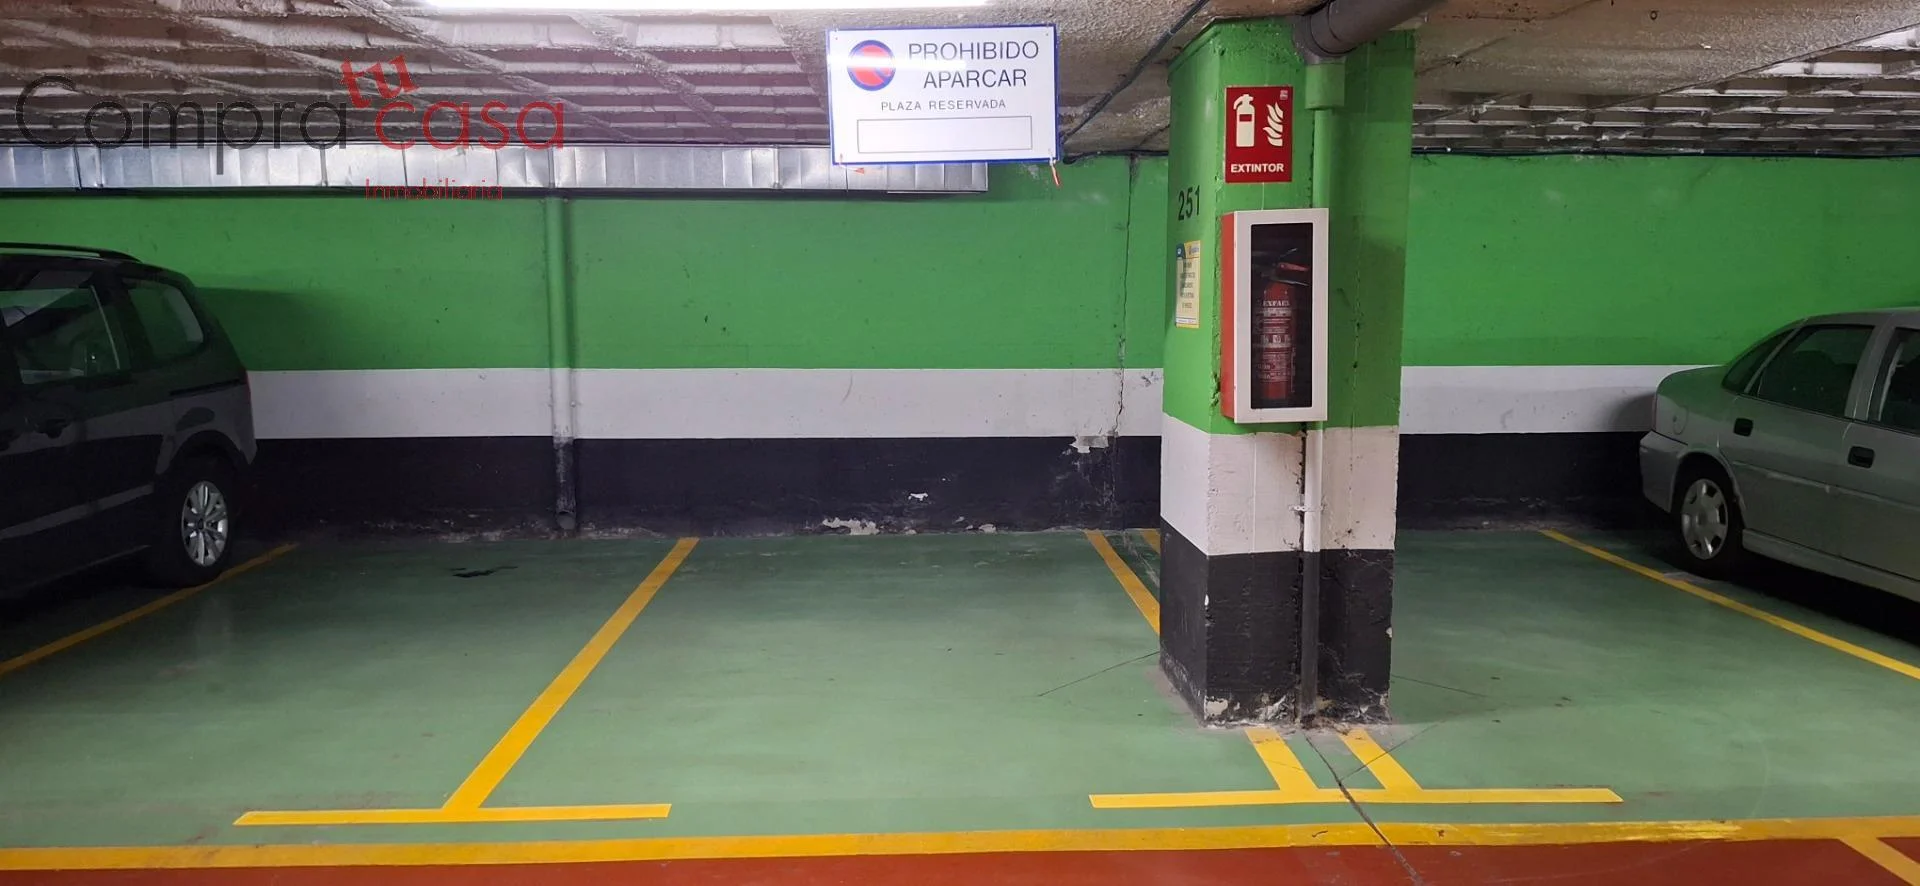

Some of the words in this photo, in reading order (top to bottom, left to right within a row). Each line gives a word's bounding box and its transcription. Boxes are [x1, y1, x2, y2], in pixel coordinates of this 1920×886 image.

[908, 40, 1039, 61] PROHIBIDO
[923, 68, 1027, 89] APARCAR
[881, 101, 922, 112] PLAZA
[928, 98, 1006, 111] RESERVADA
[1230, 163, 1285, 174] EXTINTOR
[1178, 185, 1200, 221] 251
